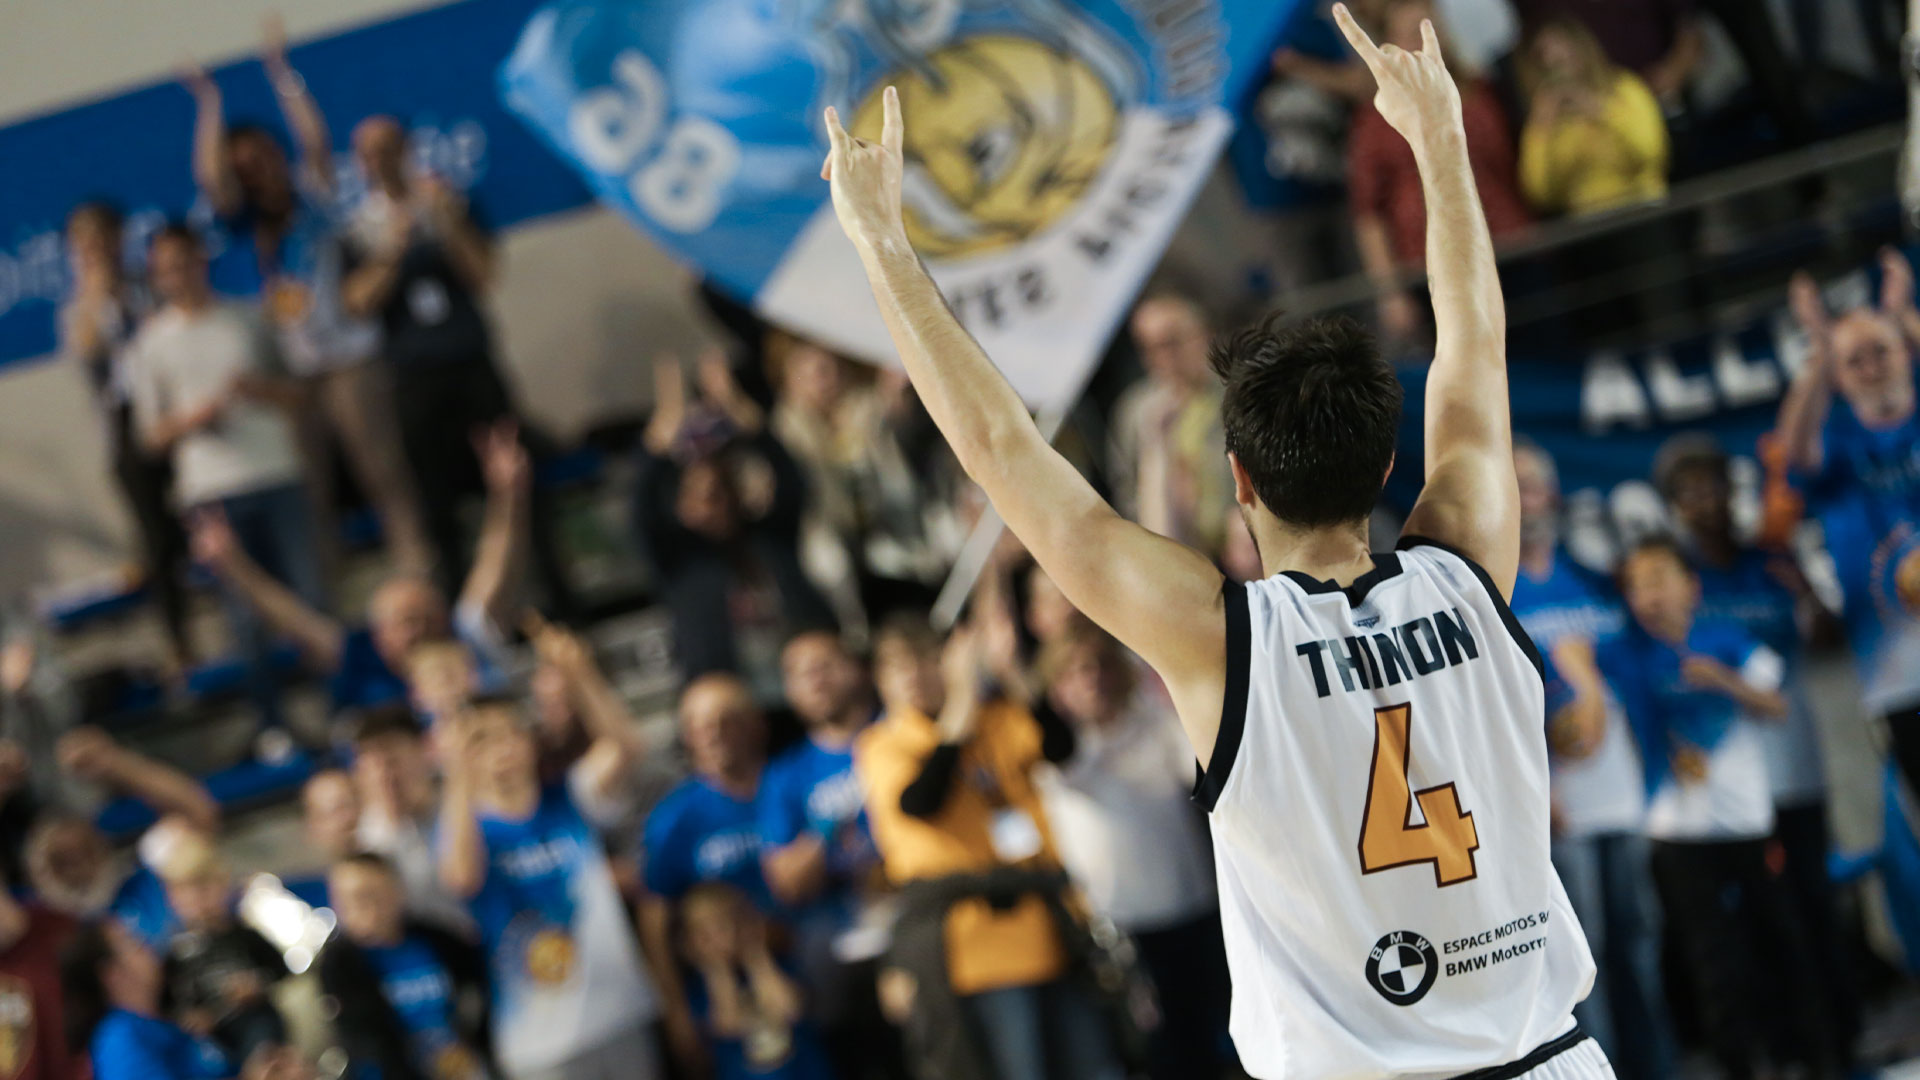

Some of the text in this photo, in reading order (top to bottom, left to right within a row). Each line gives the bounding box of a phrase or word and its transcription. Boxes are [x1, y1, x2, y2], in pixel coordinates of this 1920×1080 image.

[1295, 607, 1479, 698] THINON
[1357, 701, 1480, 888] 4
[1370, 931, 1430, 961] BMW
[1443, 910, 1549, 955] ESPACE MOTOS 8
[1445, 954, 1488, 977] BMW
